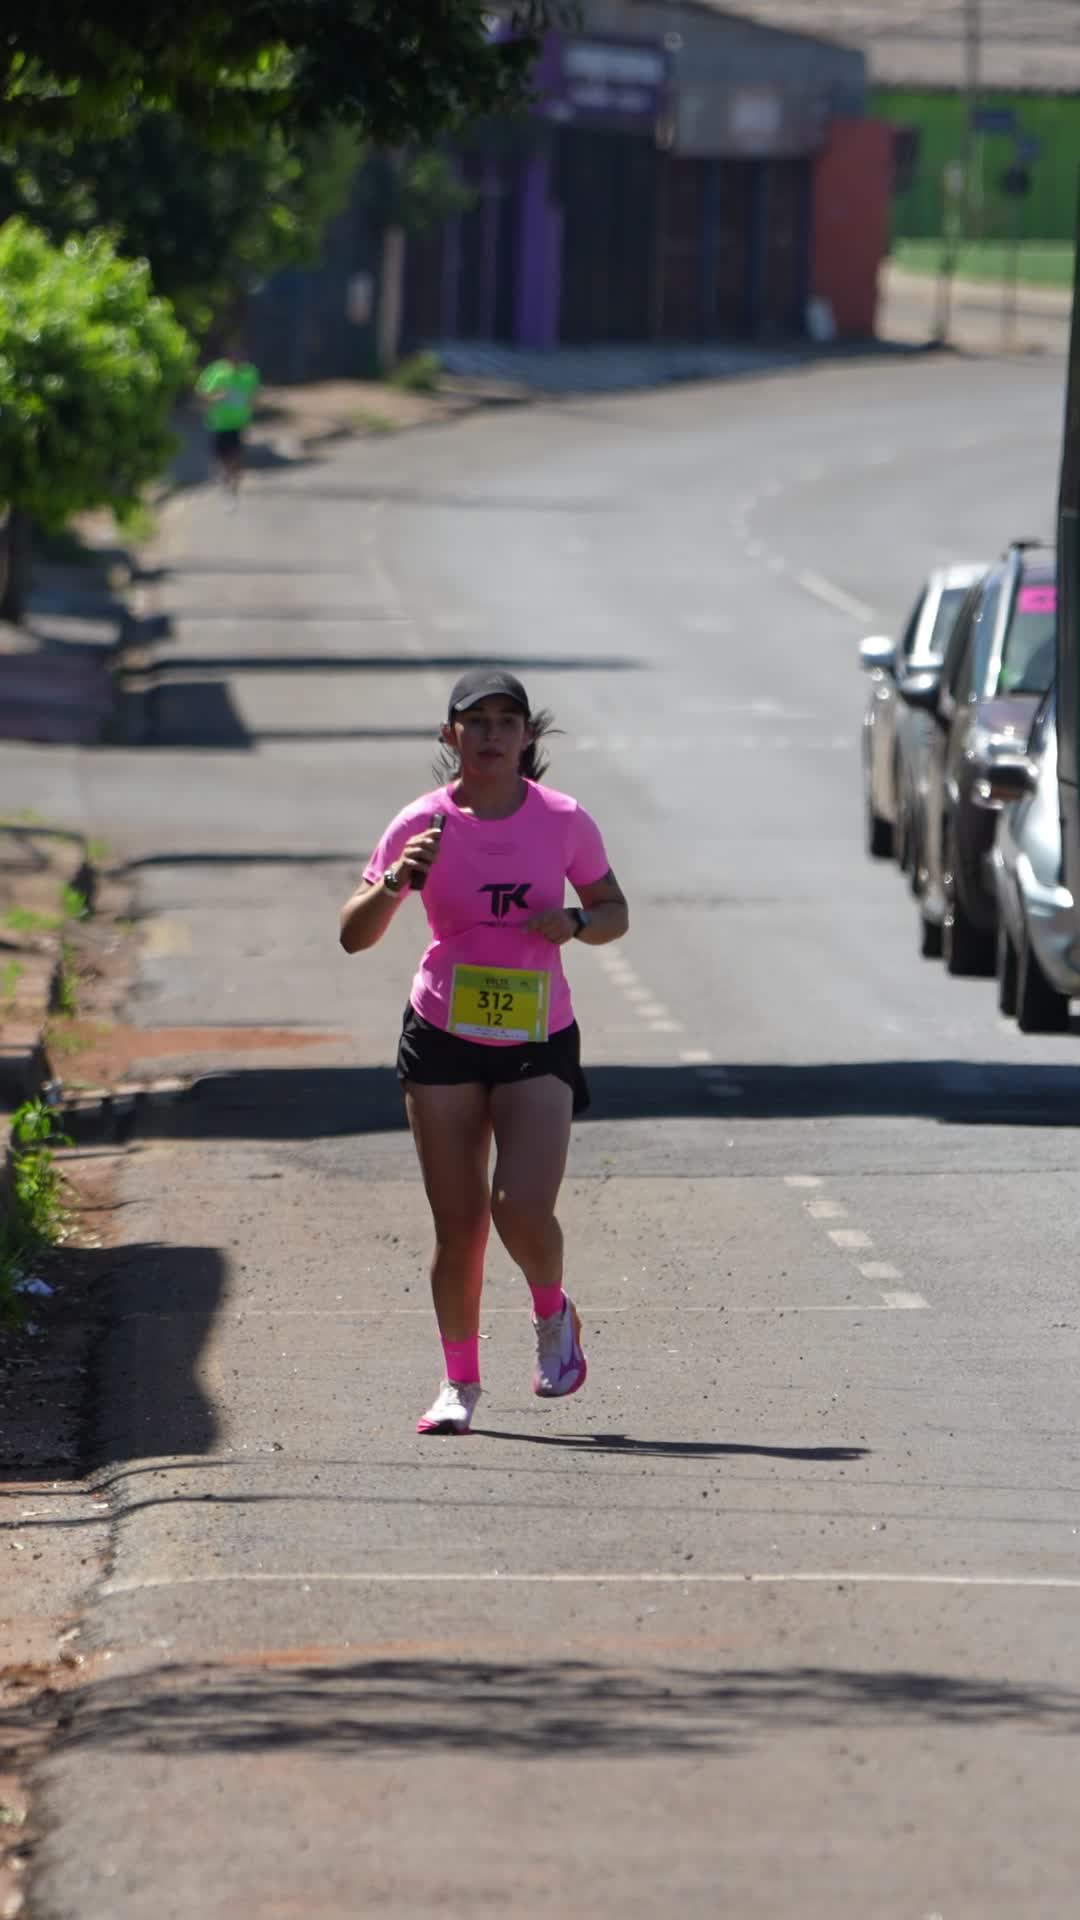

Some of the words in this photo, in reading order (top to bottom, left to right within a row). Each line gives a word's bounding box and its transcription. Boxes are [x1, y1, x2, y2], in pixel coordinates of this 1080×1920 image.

[478, 883, 531, 918] TK
[477, 991, 514, 1011] 312
[487, 1012, 503, 1026] 12
